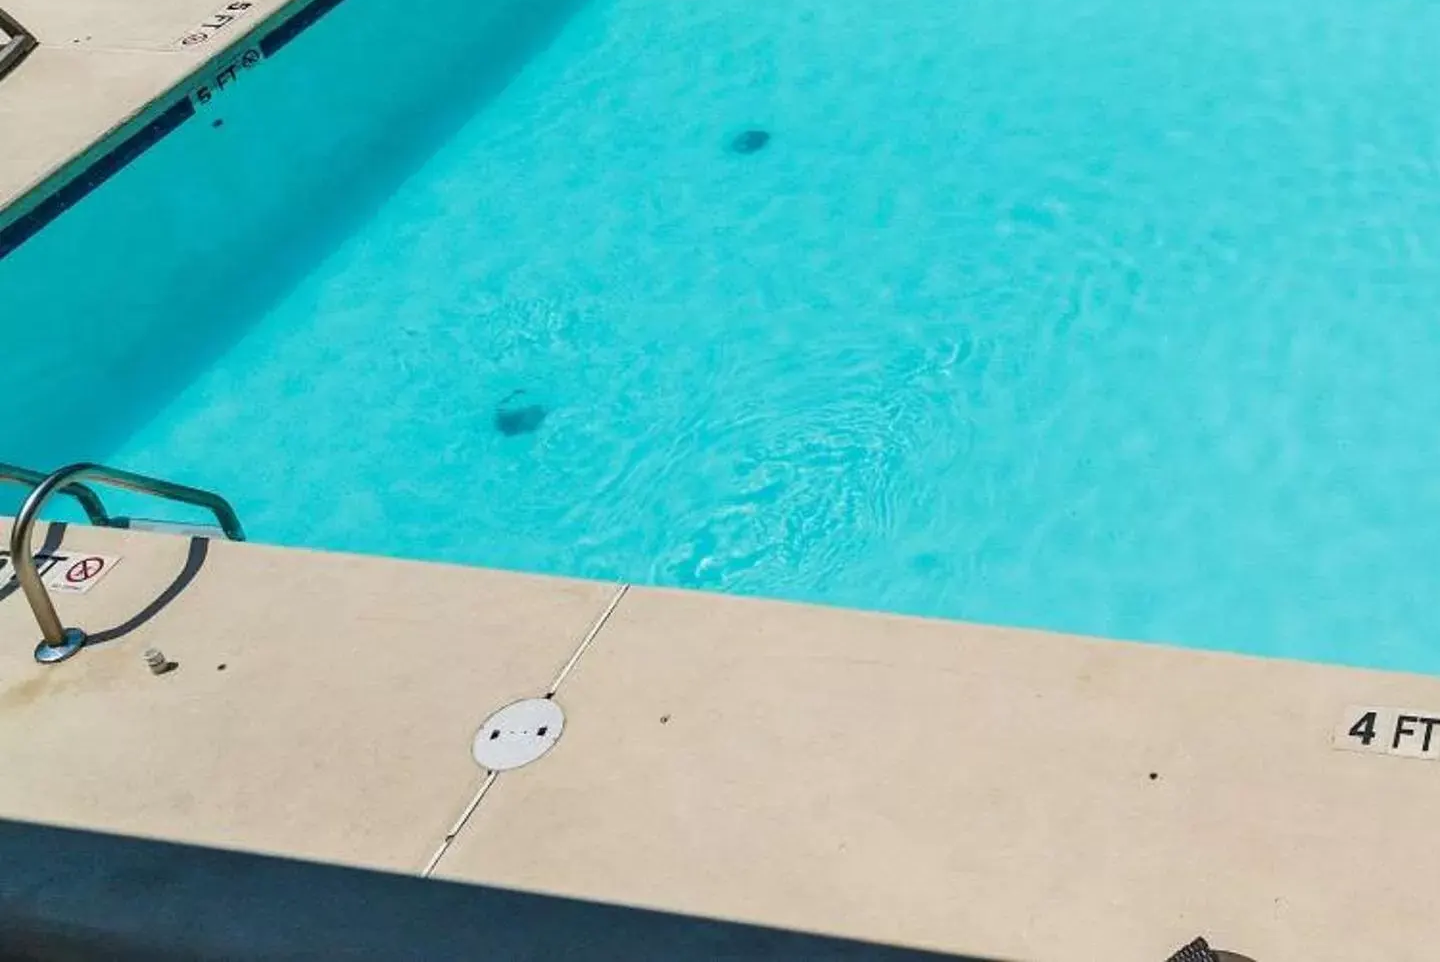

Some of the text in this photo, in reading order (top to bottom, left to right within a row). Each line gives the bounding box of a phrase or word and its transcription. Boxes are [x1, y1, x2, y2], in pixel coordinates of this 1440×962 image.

[202, 14, 234, 29] FT
[216, 63, 237, 91] FT
[1348, 711, 1377, 746] 4
